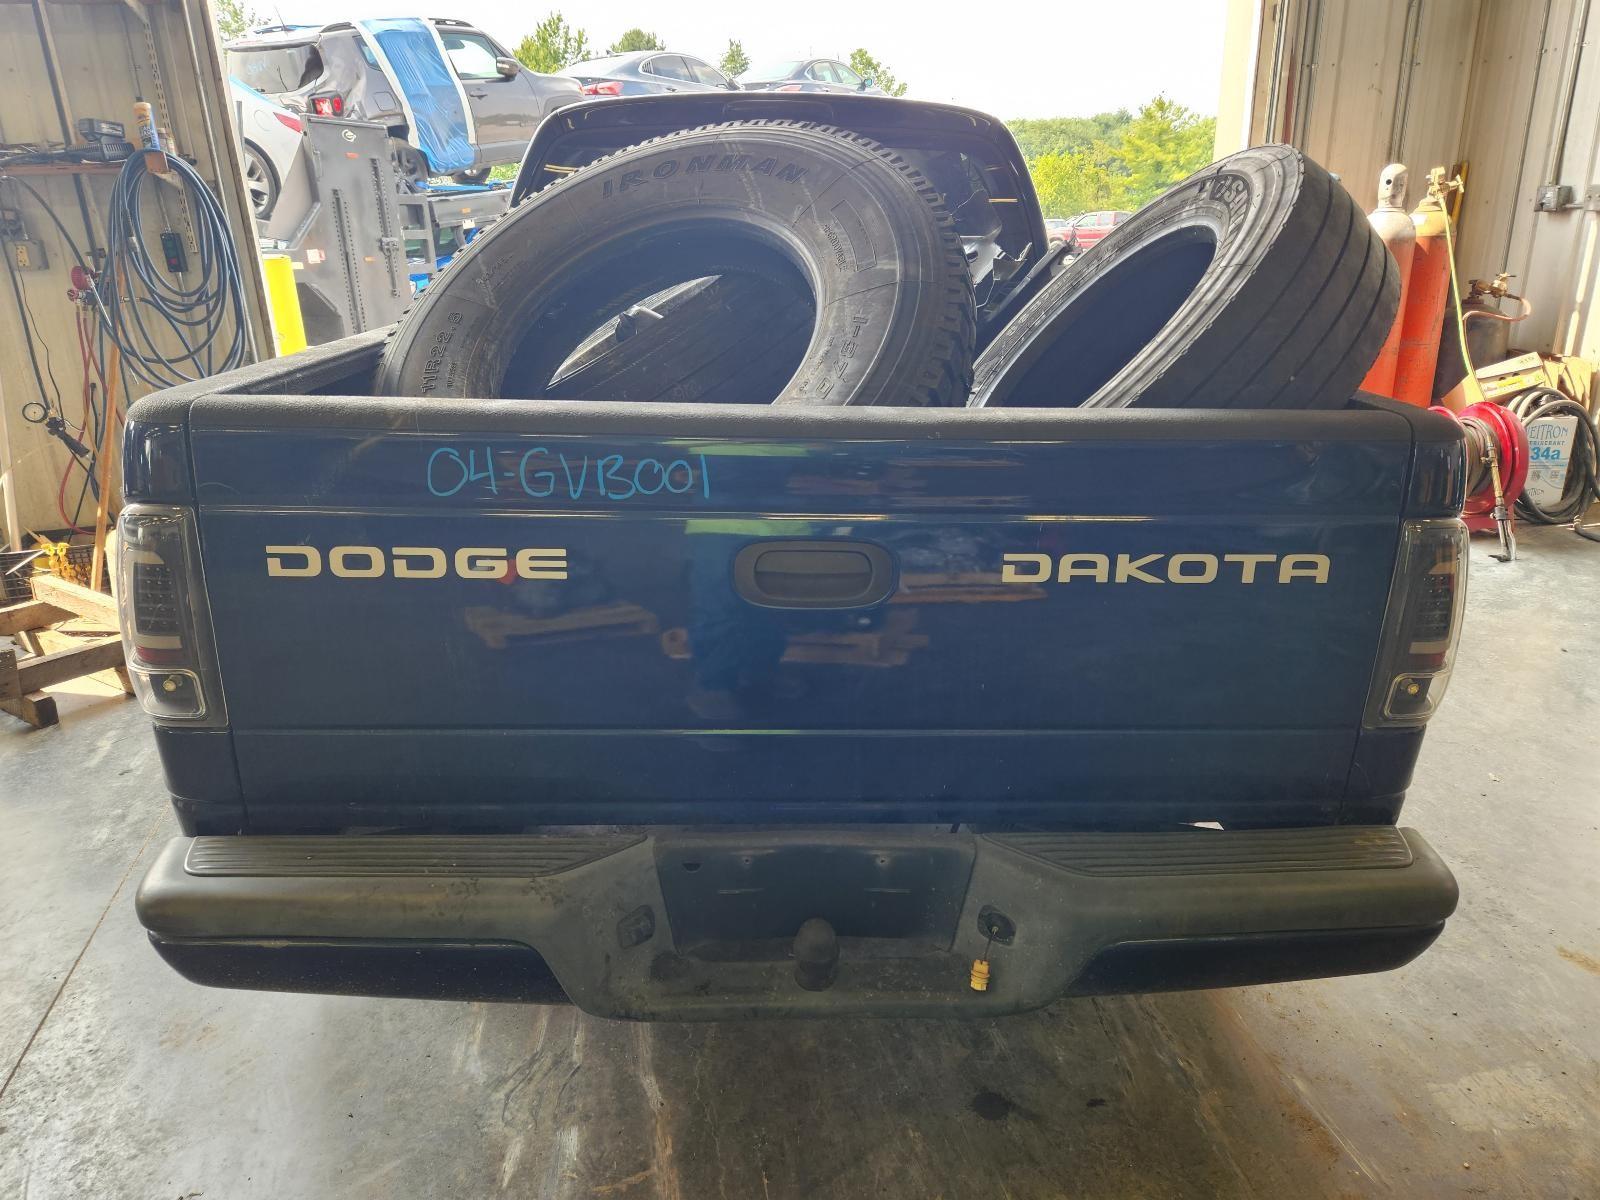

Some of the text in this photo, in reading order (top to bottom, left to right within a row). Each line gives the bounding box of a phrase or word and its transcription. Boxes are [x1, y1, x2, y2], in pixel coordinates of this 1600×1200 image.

[601, 154, 809, 200] IRONMAN
[421, 312, 463, 393] 11R22.5
[1528, 424, 1569, 440] EITRON
[1530, 446, 1561, 460] 34a
[427, 447, 710, 499] 04-GVB001
[265, 545, 568, 580] DODGE
[1001, 553, 1331, 584] DAKOTA
